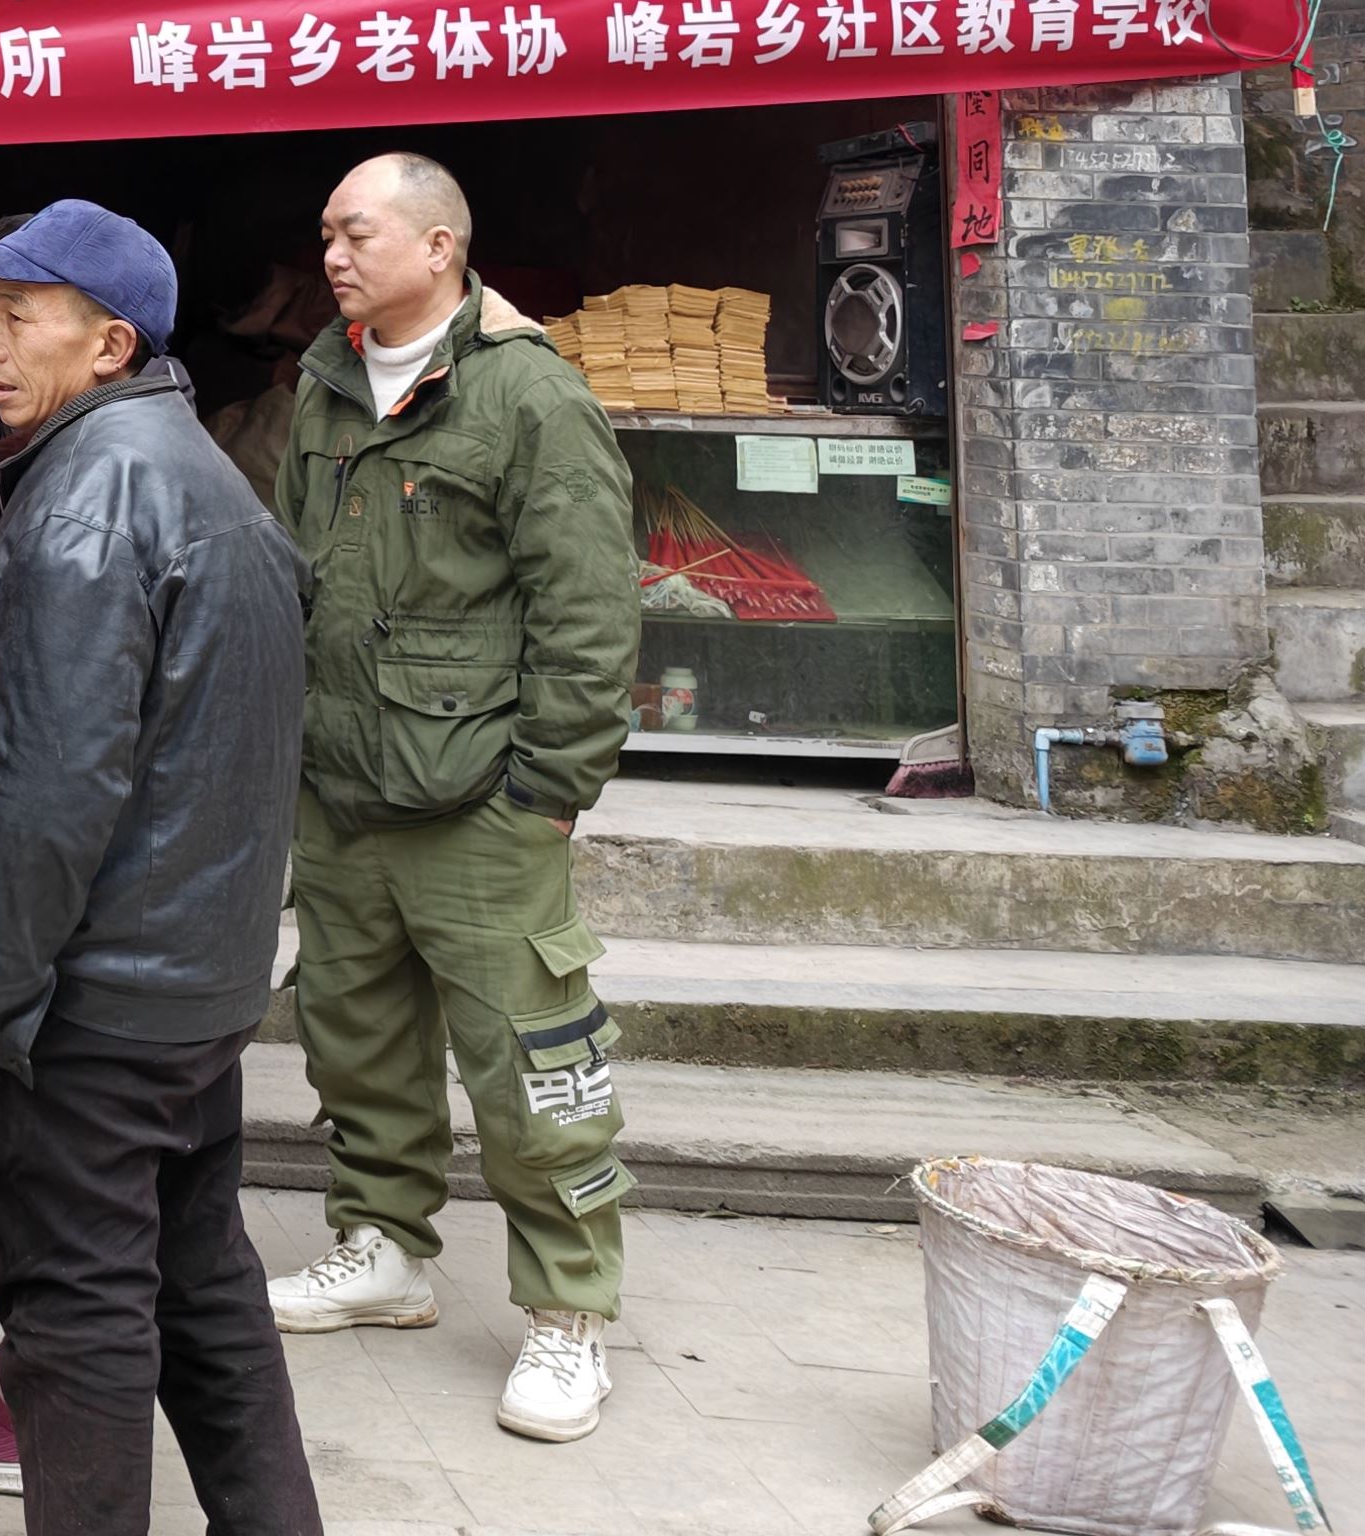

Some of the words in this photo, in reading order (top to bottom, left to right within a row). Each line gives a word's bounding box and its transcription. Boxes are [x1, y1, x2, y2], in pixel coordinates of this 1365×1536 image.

[129, 5, 567, 93] 峰岩乡老体协
